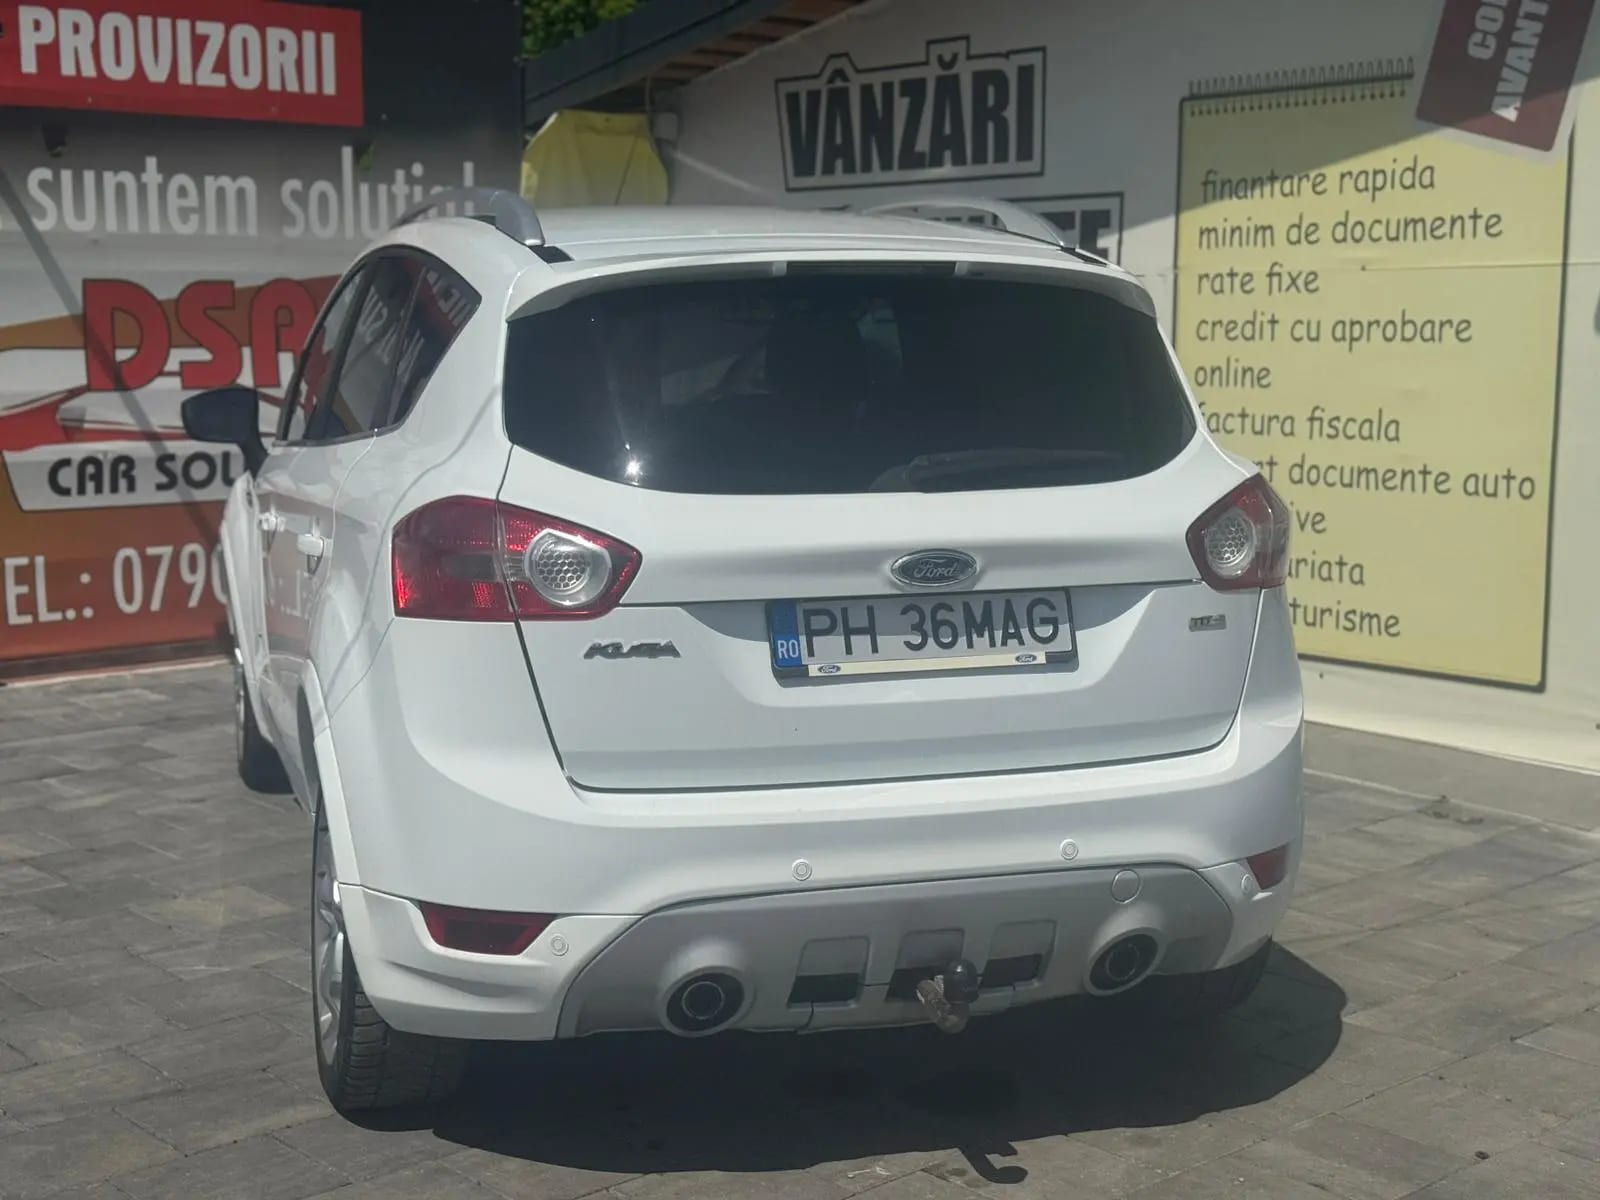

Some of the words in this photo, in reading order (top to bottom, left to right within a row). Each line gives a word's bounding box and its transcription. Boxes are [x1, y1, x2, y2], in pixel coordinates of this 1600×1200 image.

[18, 5, 337, 96] PROVIZORII
[1467, 0, 1509, 60] CO
[785, 52, 1036, 178] VÂNZĂRI
[27, 155, 258, 237] suntem
[1201, 168, 1328, 204] finantare
[1339, 154, 1436, 203] rapida
[1198, 217, 1275, 250] minim
[1286, 212, 1321, 246] de
[1331, 207, 1504, 245] documente
[1196, 267, 1256, 295] rate
[1265, 261, 1321, 296] fixe
[82, 278, 320, 391] DSA
[1195, 310, 1280, 342] credit
[1290, 317, 1321, 342] cu
[1331, 308, 1473, 352] aprobare
[1194, 357, 1272, 389] online
[1308, 405, 1401, 443] fiscala
[48, 454, 137, 497] CAR
[1288, 455, 1452, 495] documente
[1462, 466, 1536, 501] auto
[913, 558, 960, 578] Ford
[777, 639, 800, 659] RO
[802, 604, 880, 658] PH
